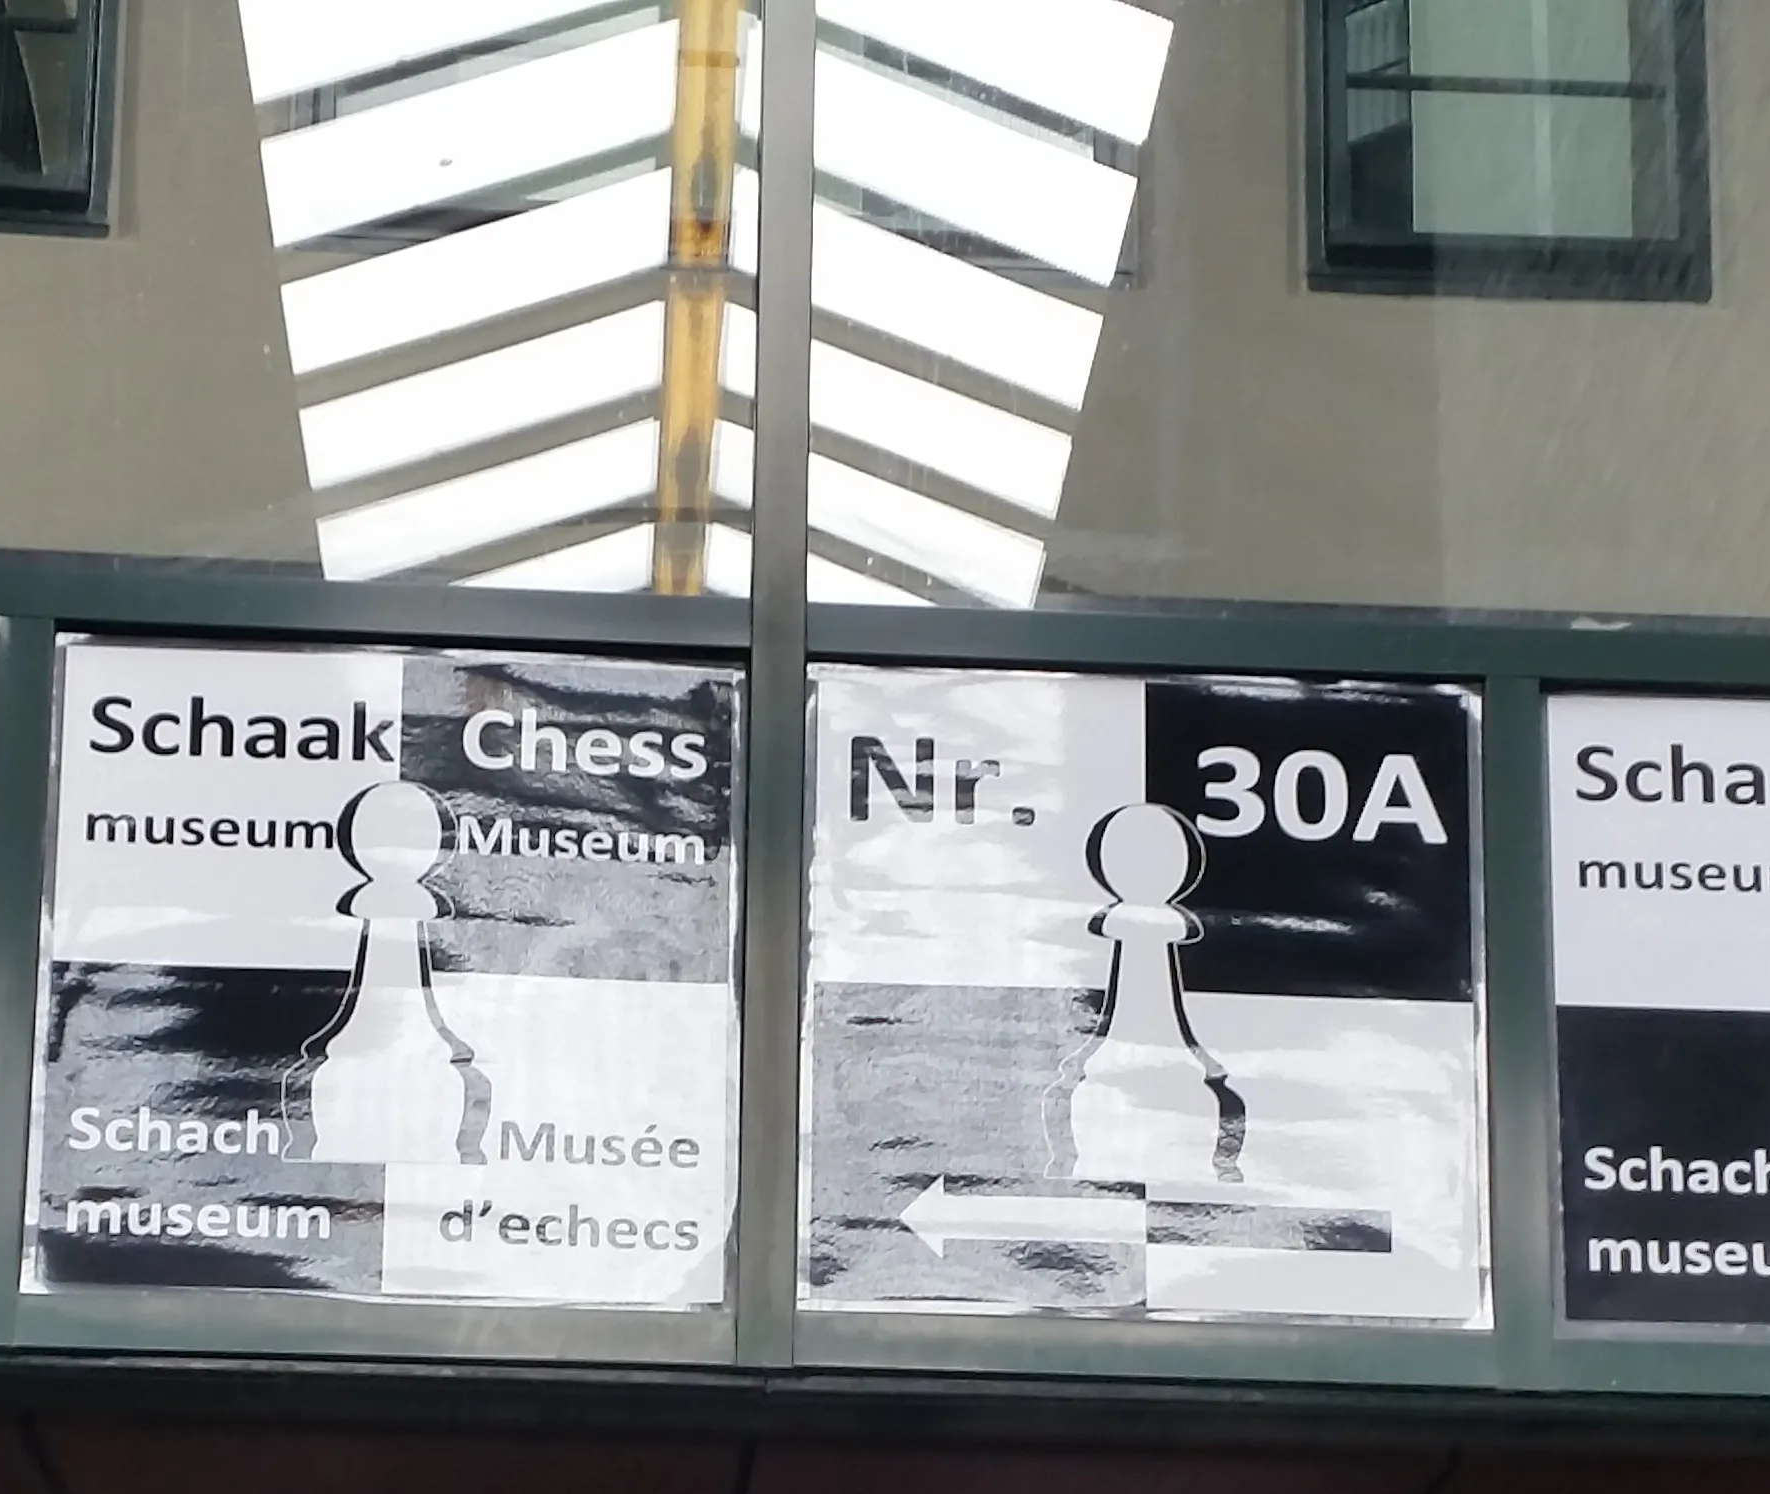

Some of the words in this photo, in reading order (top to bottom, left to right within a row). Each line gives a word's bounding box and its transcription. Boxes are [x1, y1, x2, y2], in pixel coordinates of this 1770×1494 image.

[89, 695, 397, 764] Schaak
[462, 709, 709, 779] Chess
[849, 735, 1036, 827] Nr.
[1194, 746, 1448, 845] 30A
[84, 810, 335, 850] museum
[457, 815, 707, 866] Museum
[68, 1106, 281, 1156] Schach
[498, 1120, 701, 1170] Musée
[64, 1198, 331, 1240] museum
